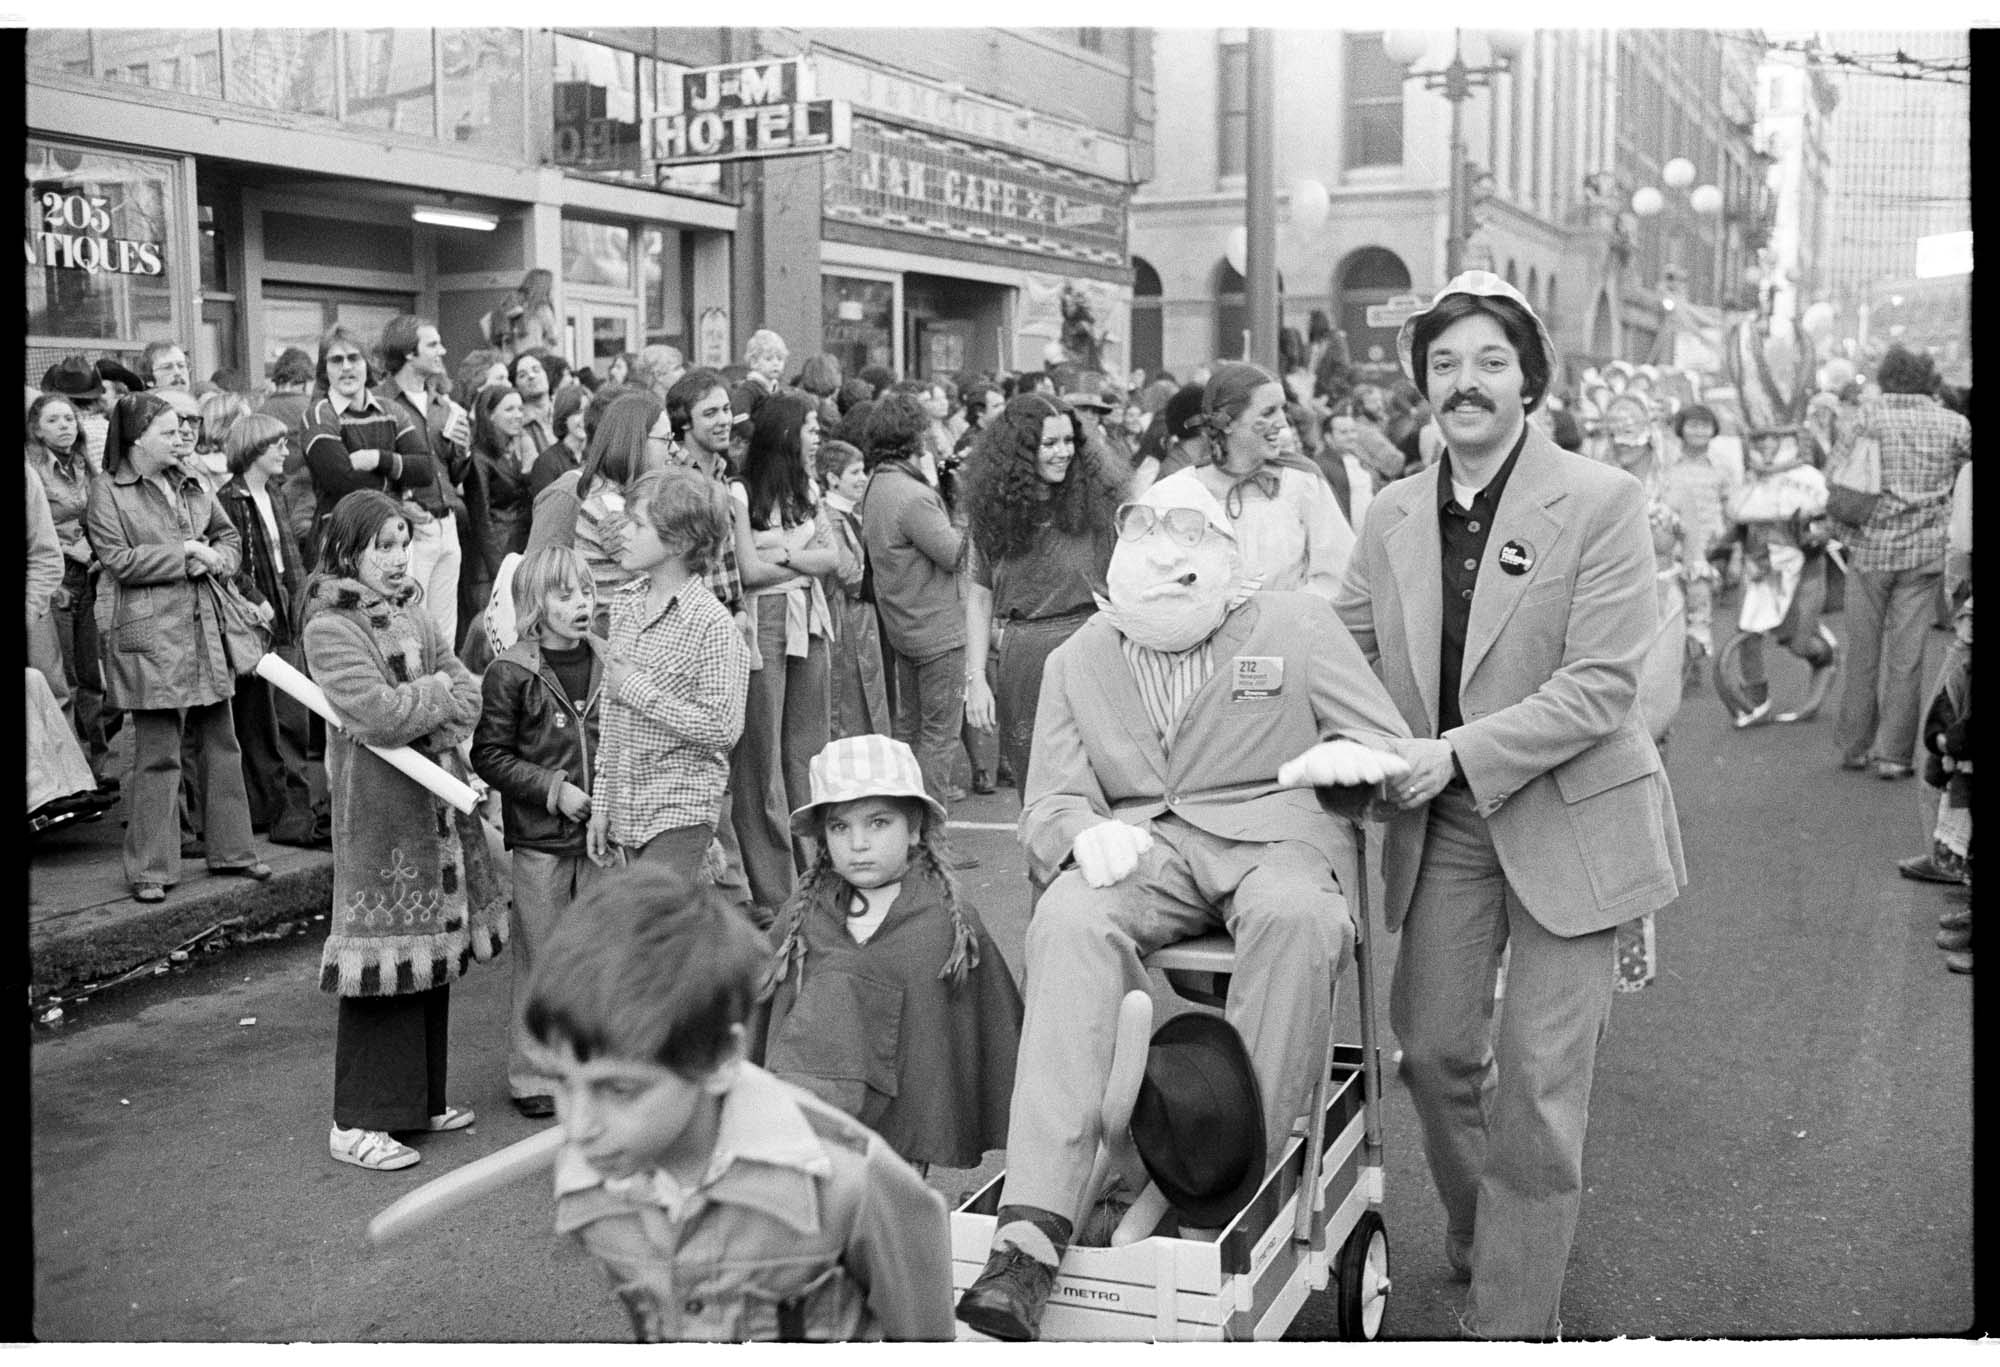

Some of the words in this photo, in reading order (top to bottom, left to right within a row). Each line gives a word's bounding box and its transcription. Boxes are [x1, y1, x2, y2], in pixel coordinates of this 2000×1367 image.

[656, 102, 829, 159] HOTEL
[42, 191, 110, 232] 205
[943, 169, 1018, 218] CAFE
[1239, 660, 1257, 673] 212
[1063, 1286, 1120, 1302] METRO
